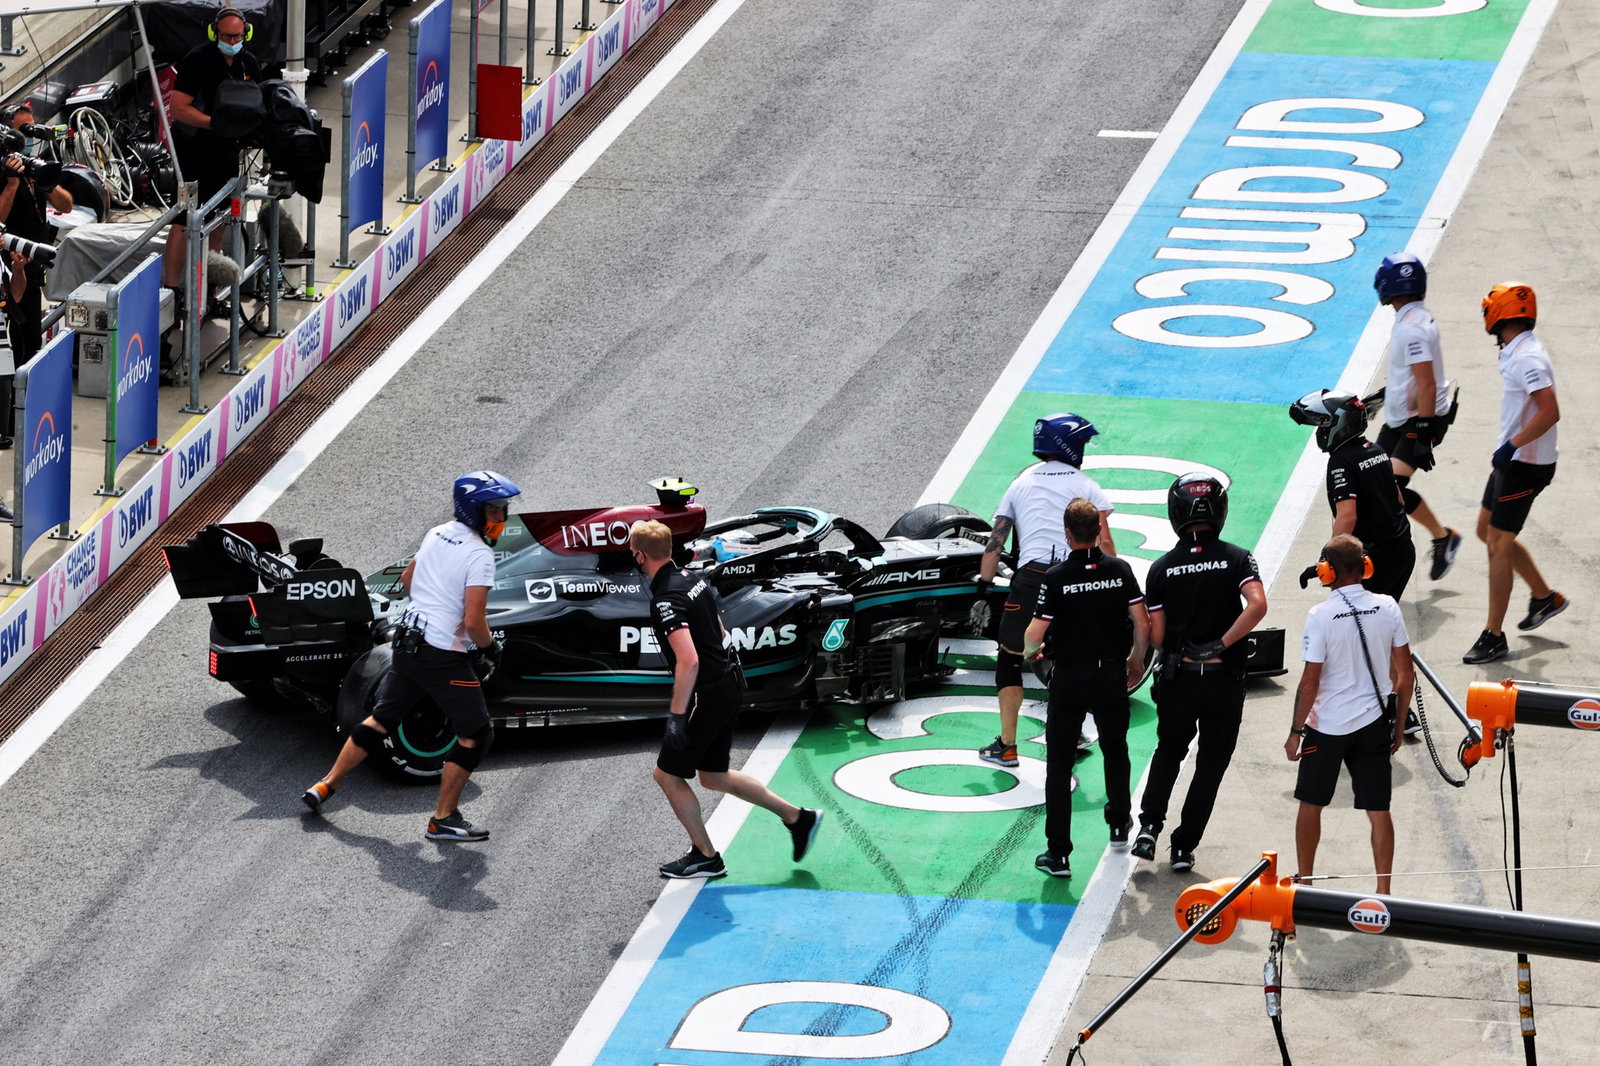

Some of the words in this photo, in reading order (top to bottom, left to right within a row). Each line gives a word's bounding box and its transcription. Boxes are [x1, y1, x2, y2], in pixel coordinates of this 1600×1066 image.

[603, 21, 620, 62] BWT
[565, 59, 583, 100] BWT
[525, 99, 543, 141] BWT
[440, 183, 459, 228] BWT
[1111, 98, 1425, 348] aramco
[395, 227, 415, 273] BWT
[347, 273, 367, 321] BWT
[297, 310, 321, 347] CHANGE
[301, 331, 320, 361] WORLD
[244, 373, 266, 424] BWT
[188, 428, 212, 480] BWT
[1190, 485, 1212, 493] INEOS
[129, 485, 153, 540] BWT
[561, 519, 646, 548] INEO
[66, 530, 96, 574] CHANGE
[234, 543, 280, 579] INEOS
[1166, 560, 1228, 577] PETRONAS
[72, 554, 96, 590] WORLD
[559, 580, 641, 594] TeamViewer
[722, 565, 746, 576] AMD
[884, 568, 941, 584] AMG
[1062, 578, 1123, 595] PETRONAS
[286, 579, 356, 601] EPSON
[0, 608, 27, 668] BWT
[286, 653, 331, 663] ACCELERATE
[1570, 710, 1600, 722] Gul
[1350, 910, 1388, 925] Gulf
